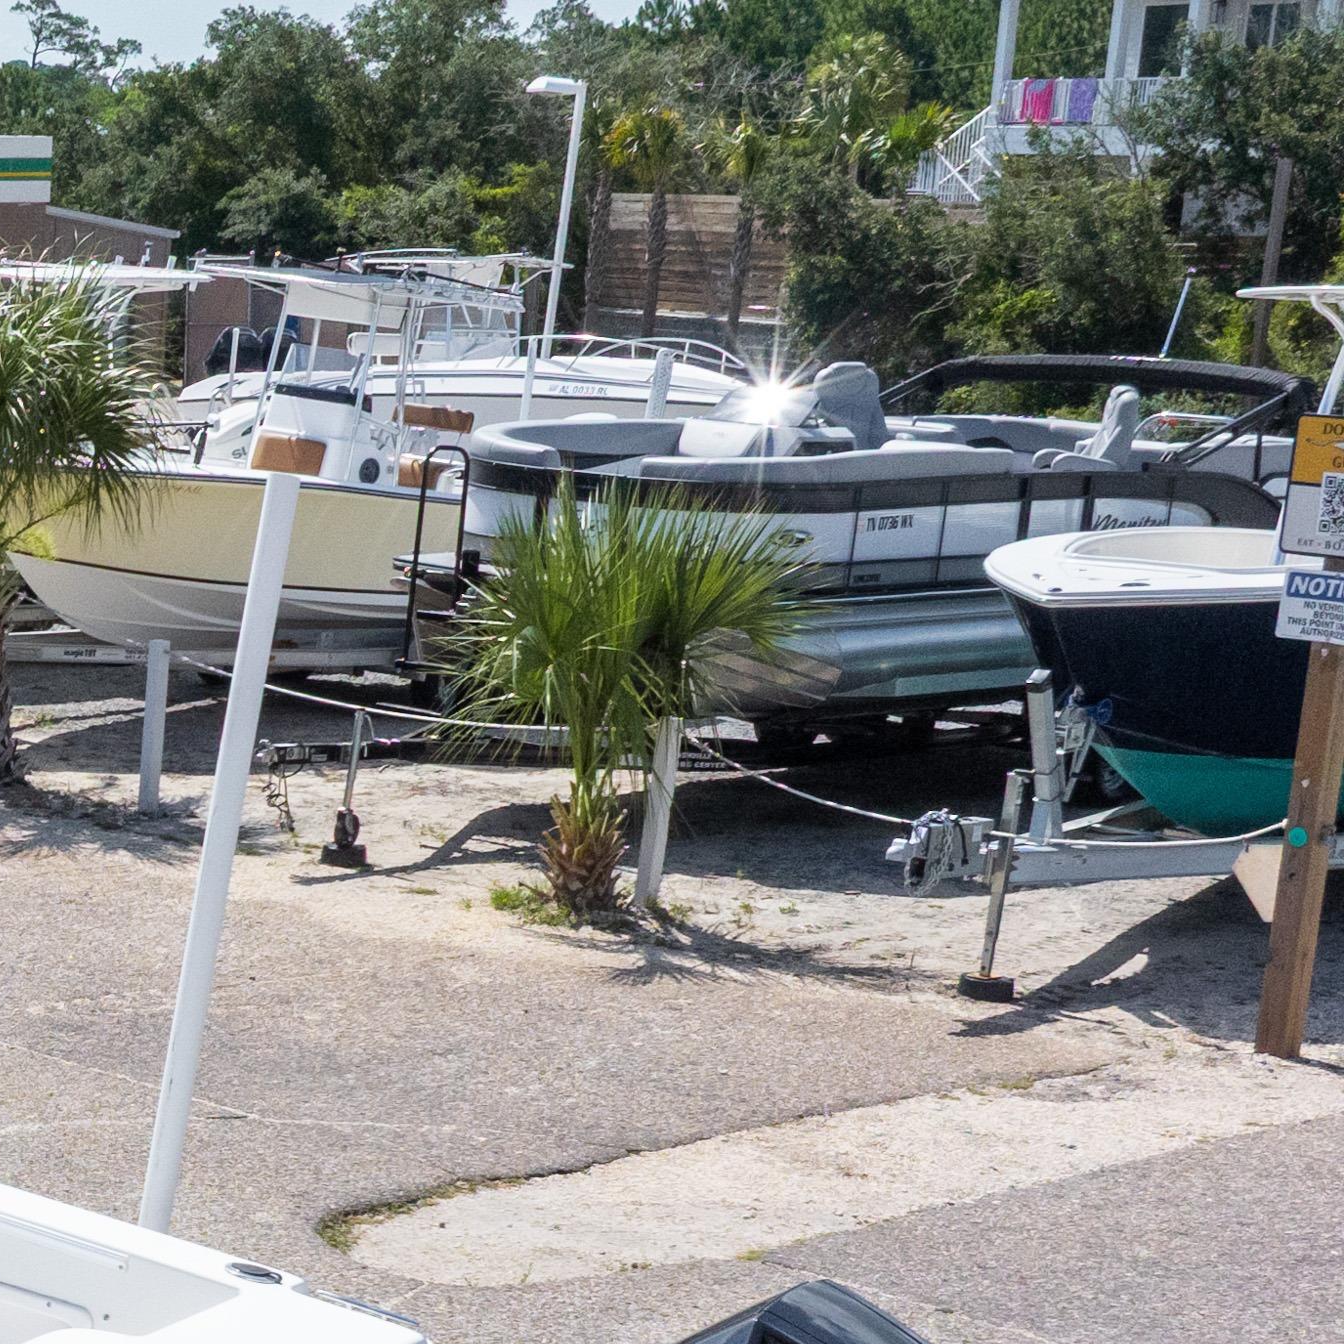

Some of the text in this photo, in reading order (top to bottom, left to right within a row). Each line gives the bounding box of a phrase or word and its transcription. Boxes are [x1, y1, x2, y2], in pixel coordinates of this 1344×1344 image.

[1333, 456, 1344, 468] G
[1325, 540, 1344, 551] BO
[1303, 601, 1344, 613] NO VEHIC
[1288, 617, 1307, 626] THIS
[1309, 619, 1334, 629] POINT
